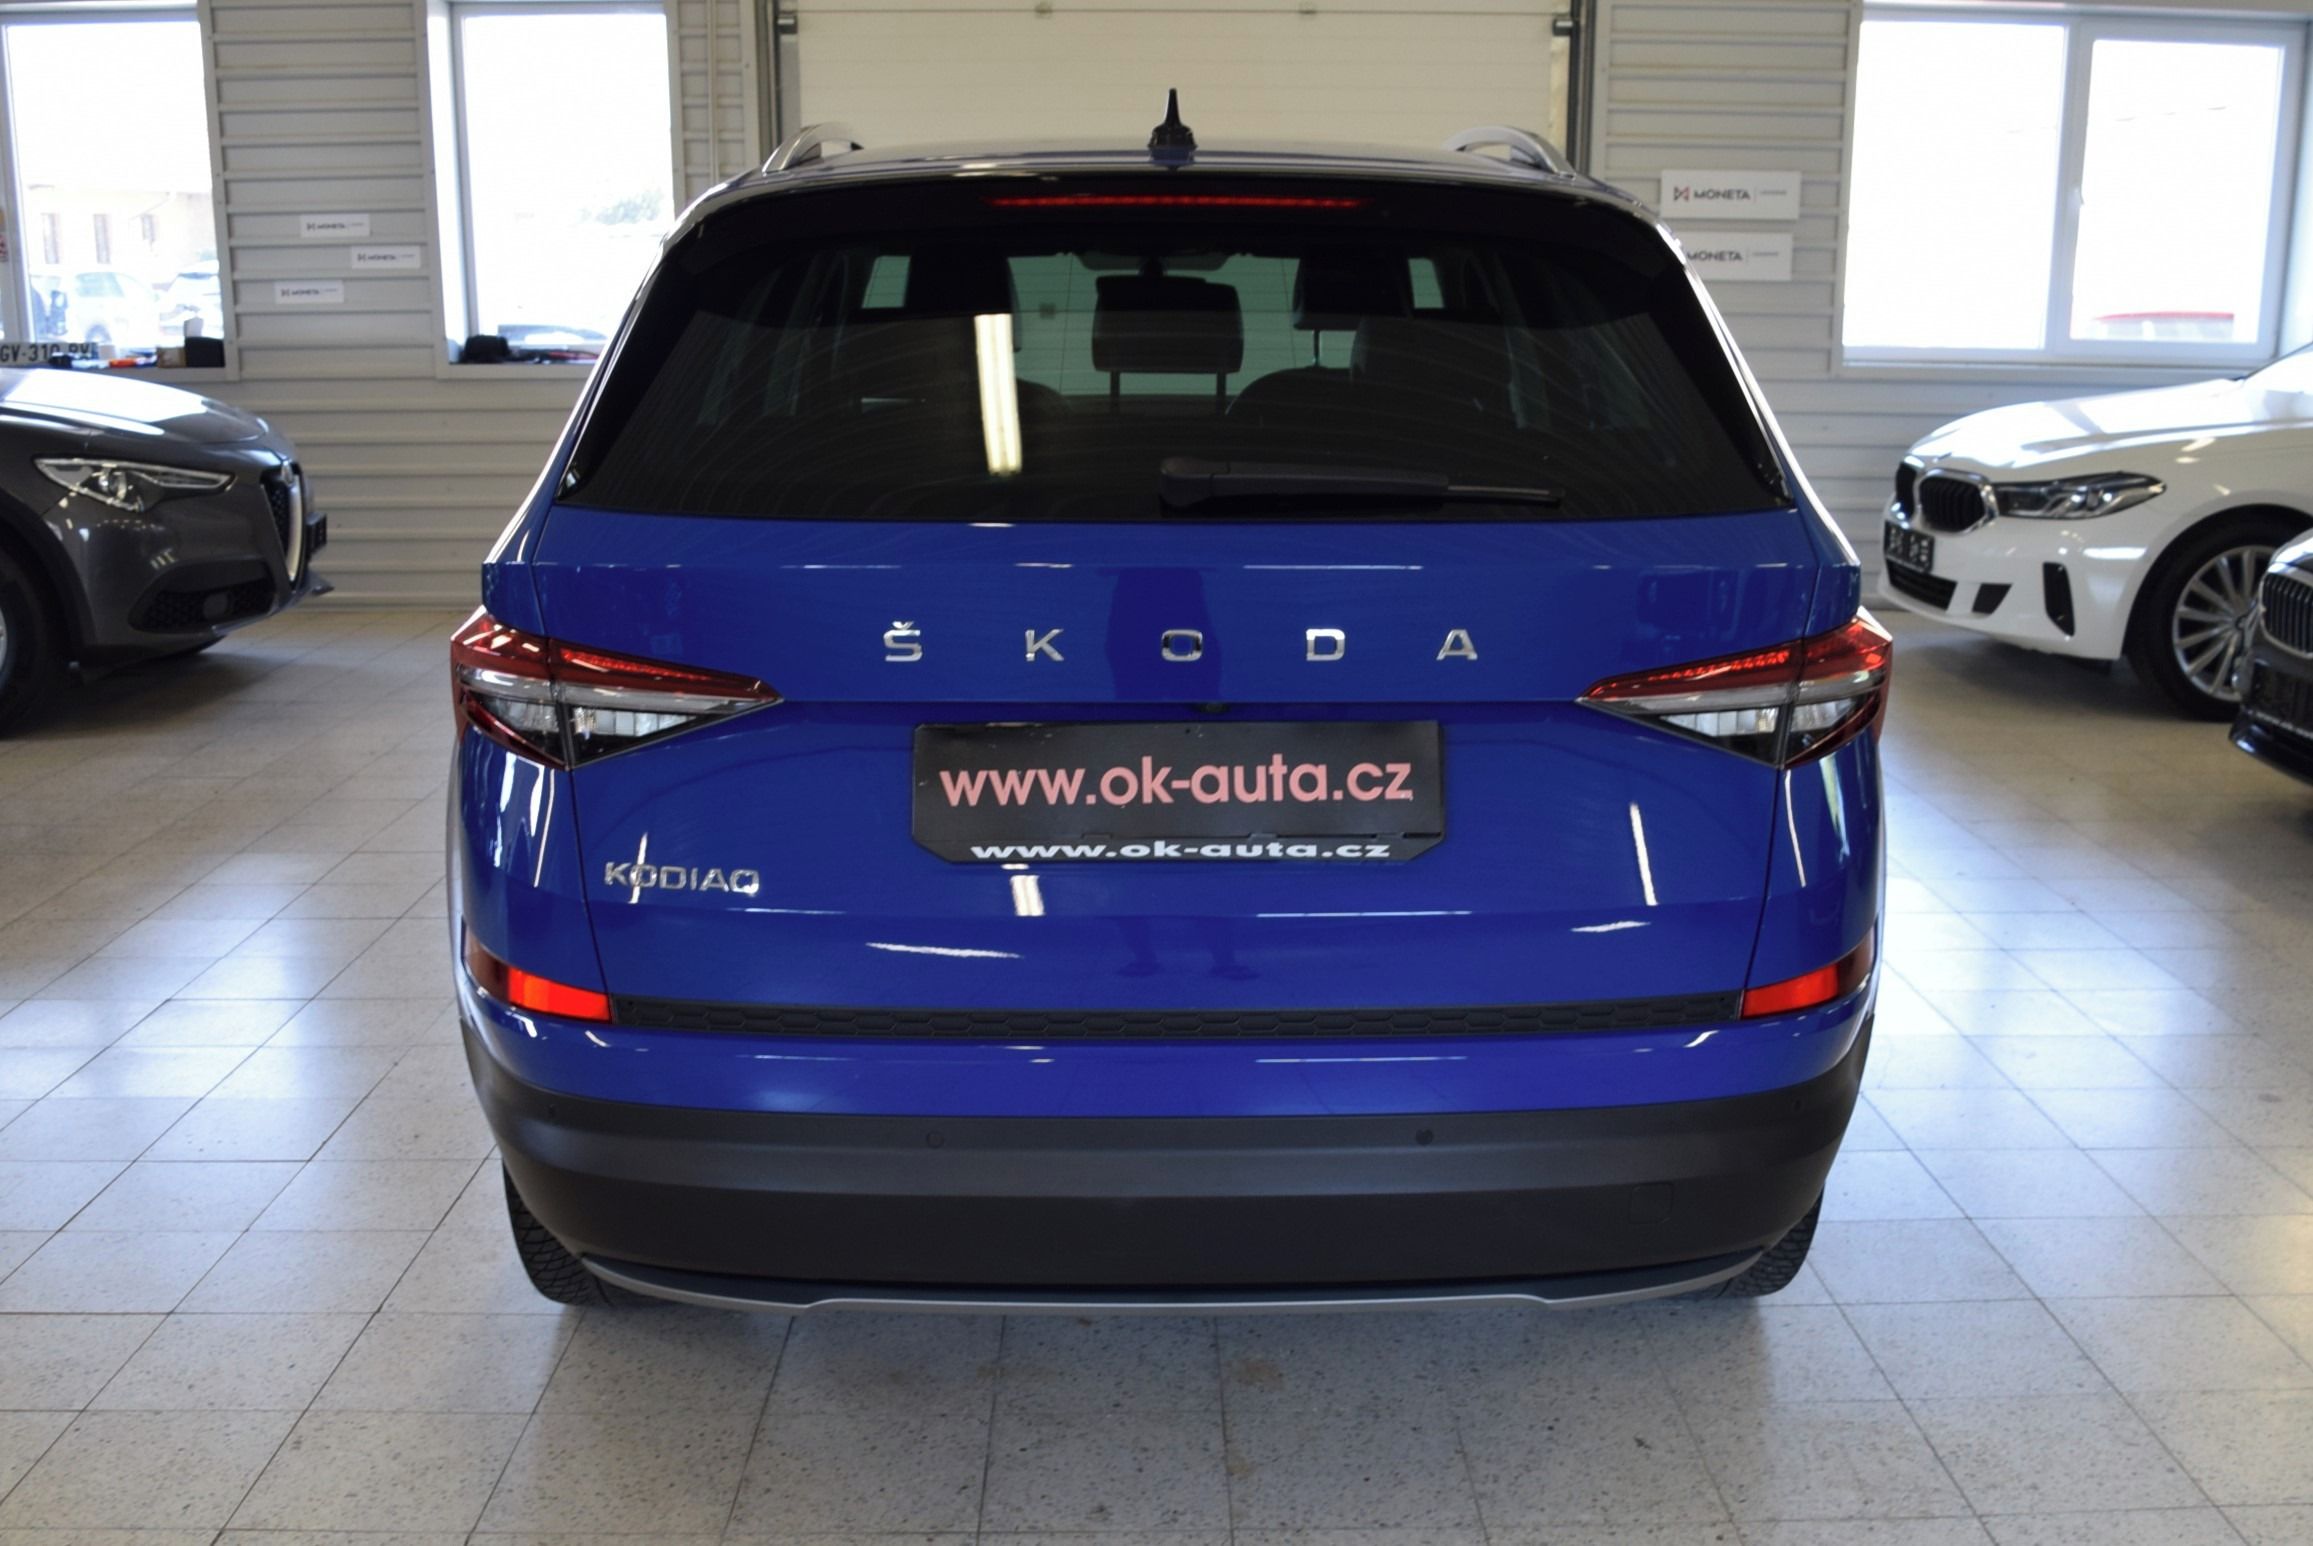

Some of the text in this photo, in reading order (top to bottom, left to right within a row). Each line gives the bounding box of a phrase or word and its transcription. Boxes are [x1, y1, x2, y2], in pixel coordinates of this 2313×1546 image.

[1693, 188, 1751, 200] MONETA
[1687, 250, 1742, 261] MONETA
[939, 753, 1414, 806] www.ok-auta.cz
[970, 841, 1390, 858] www.ok-auta.cz
[604, 861, 760, 897] KODIAQ
